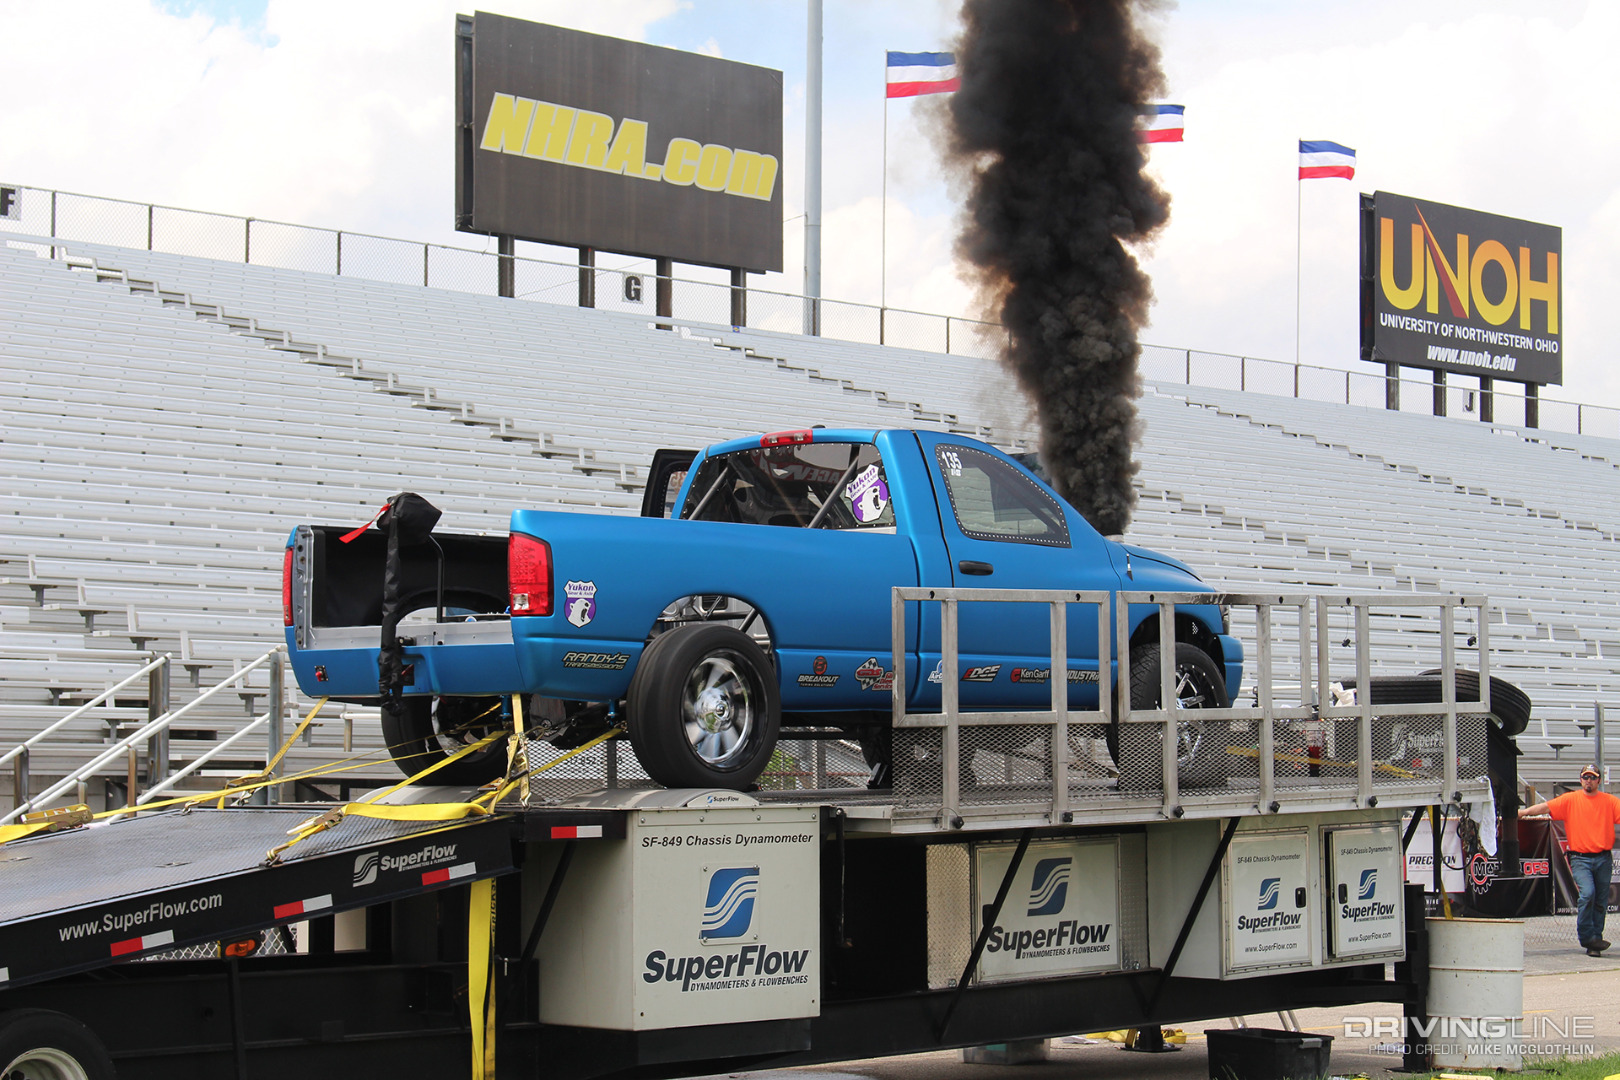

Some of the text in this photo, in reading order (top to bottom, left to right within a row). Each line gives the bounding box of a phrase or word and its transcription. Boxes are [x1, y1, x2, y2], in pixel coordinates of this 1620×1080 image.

[480, 91, 778, 201] NHRA.com
[0, 187, 16, 216] F
[1380, 203, 1559, 325] UNOH
[625, 275, 641, 301] G
[1380, 312, 1559, 353] UNIVERSITY OF NORTHWESTERN OHIO
[1427, 345, 1517, 372] www.unoh.edu
[1465, 391, 1474, 412] J
[941, 451, 963, 470] 135
[847, 467, 876, 493] Yukon
[568, 583, 594, 592] Yukon
[563, 651, 630, 664] RANDY'S
[798, 675, 839, 683] BREAKOUT
[964, 666, 1001, 679] EDGE
[713, 795, 739, 803] SuperFlow
[642, 834, 813, 847] SF-849 Chassis Dynamometer
[380, 844, 457, 872] SuperFlow
[1253, 855, 1270, 863] Chassis
[1271, 854, 1301, 863] Dynamometer
[59, 894, 223, 942] www.SuperFlow.com
[1237, 912, 1301, 934] SuperFlow
[1341, 902, 1395, 923] SuperFlow
[986, 920, 1110, 960] SuperFlow
[1245, 942, 1298, 953] www.SuperFlow.com
[1348, 932, 1391, 943] www.SuperFlow.com
[1021, 948, 1066, 959] DYNAMOMETERS
[1072, 945, 1110, 955] FLOWBENCHES
[643, 945, 810, 992] SuperFlow
[690, 975, 808, 992] DYNAMOMETERS & FLOWBENCHES
